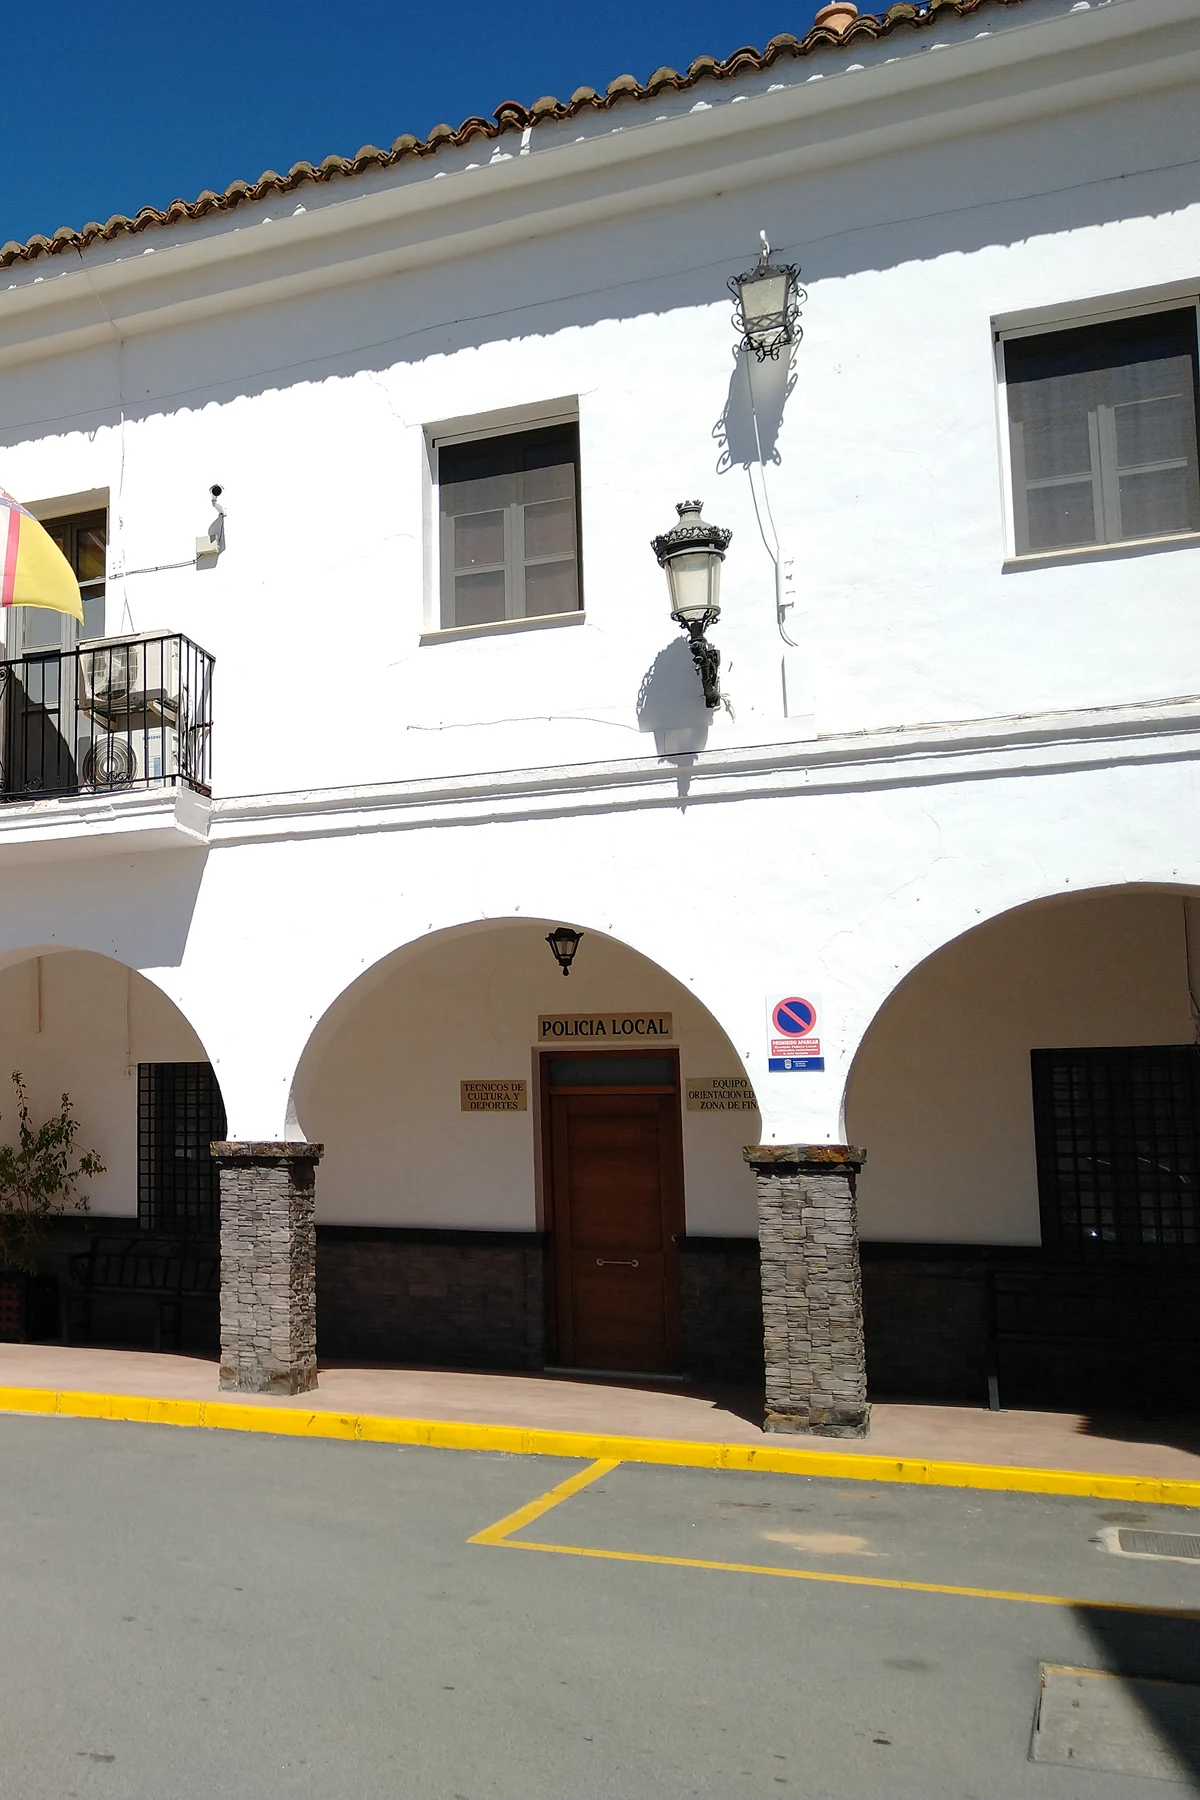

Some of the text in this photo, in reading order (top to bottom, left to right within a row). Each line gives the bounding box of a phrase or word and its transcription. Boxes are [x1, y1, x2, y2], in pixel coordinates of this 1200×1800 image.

[542, 1018, 669, 1037] POLICIA LOCAL
[464, 1083, 524, 1092] TECNICOS DE
[712, 1079, 748, 1089] EQUIPO
[467, 1092, 520, 1101] CULTURA Y
[688, 1090, 742, 1100] ORIENTACION
[470, 1101, 519, 1110] DEPORTES
[700, 1099, 759, 1110] ZONA DE FIÑ
